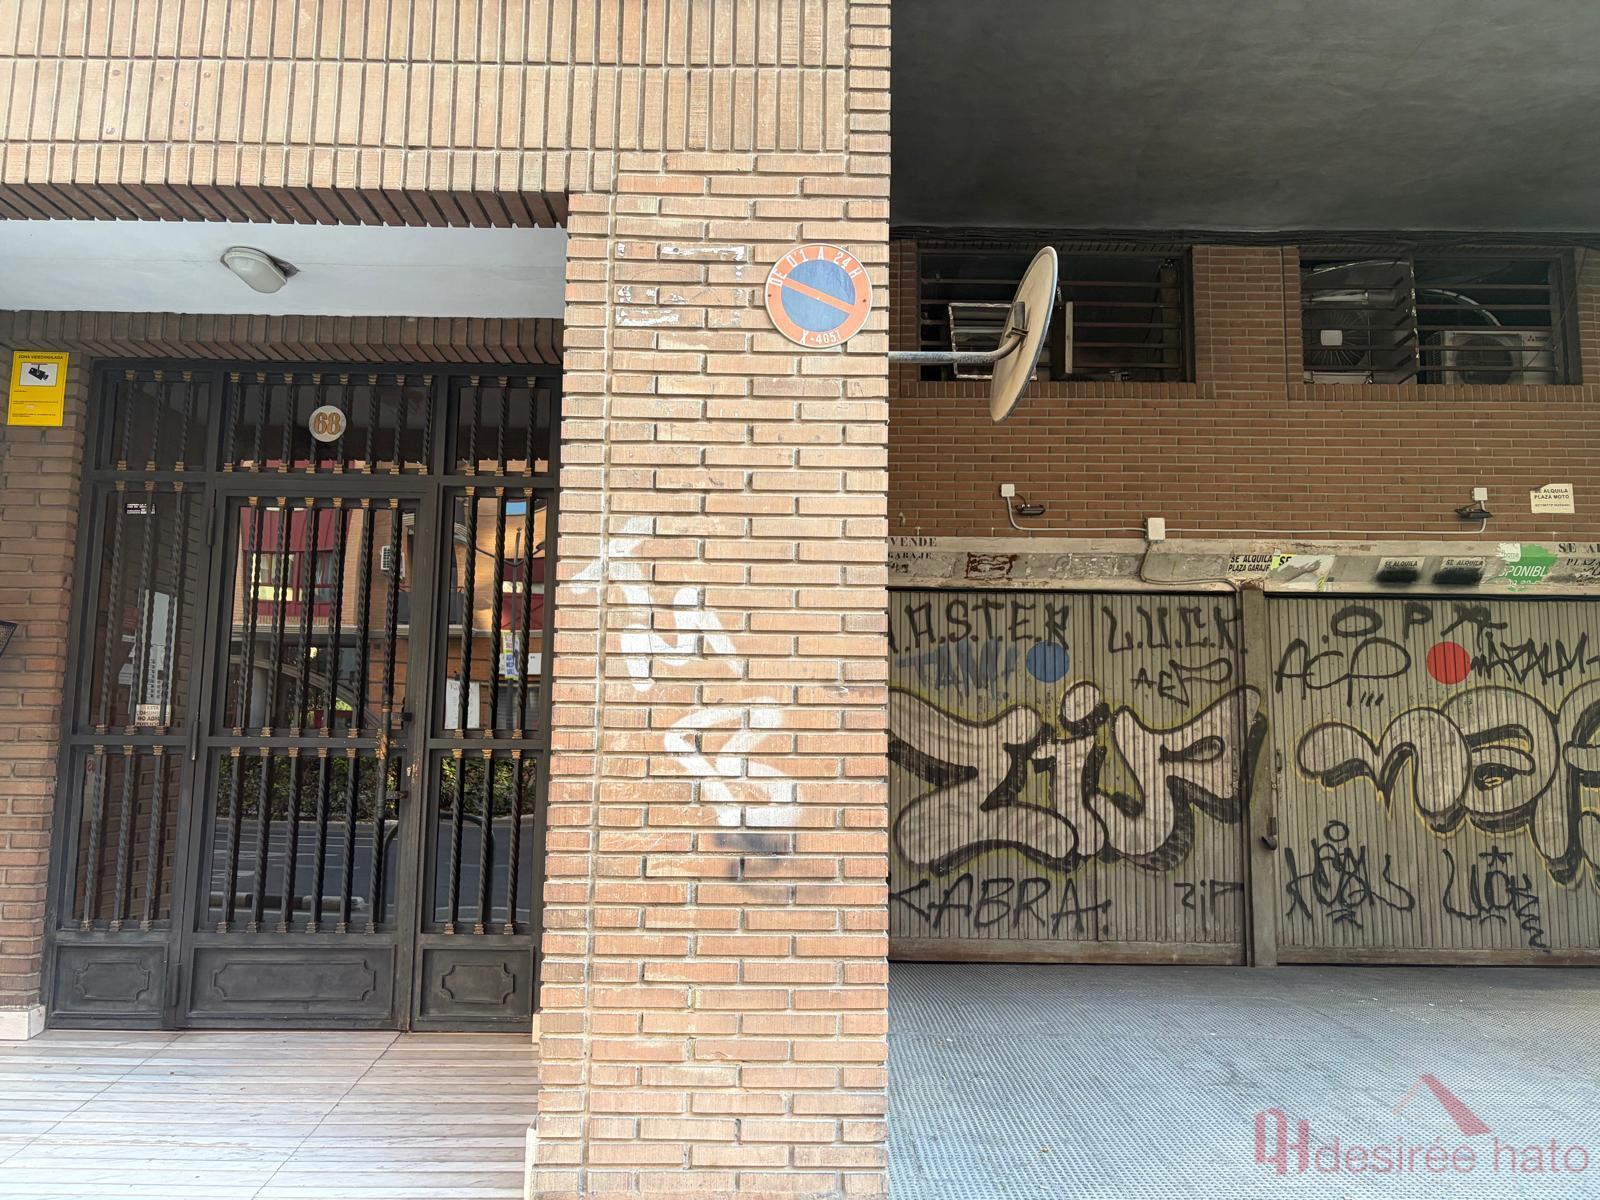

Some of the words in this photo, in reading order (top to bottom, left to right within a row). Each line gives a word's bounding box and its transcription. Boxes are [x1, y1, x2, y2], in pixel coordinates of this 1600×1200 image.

[818, 246, 824, 260] A
[833, 251, 853, 270] 24
[314, 412, 340, 435] 68
[890, 537, 937, 547] VENDE
[1559, 543, 1577, 553] SE
[1230, 555, 1240, 563] SE
[1243, 554, 1273, 563] ALQUILA
[1228, 564, 1246, 572] PLAZA
